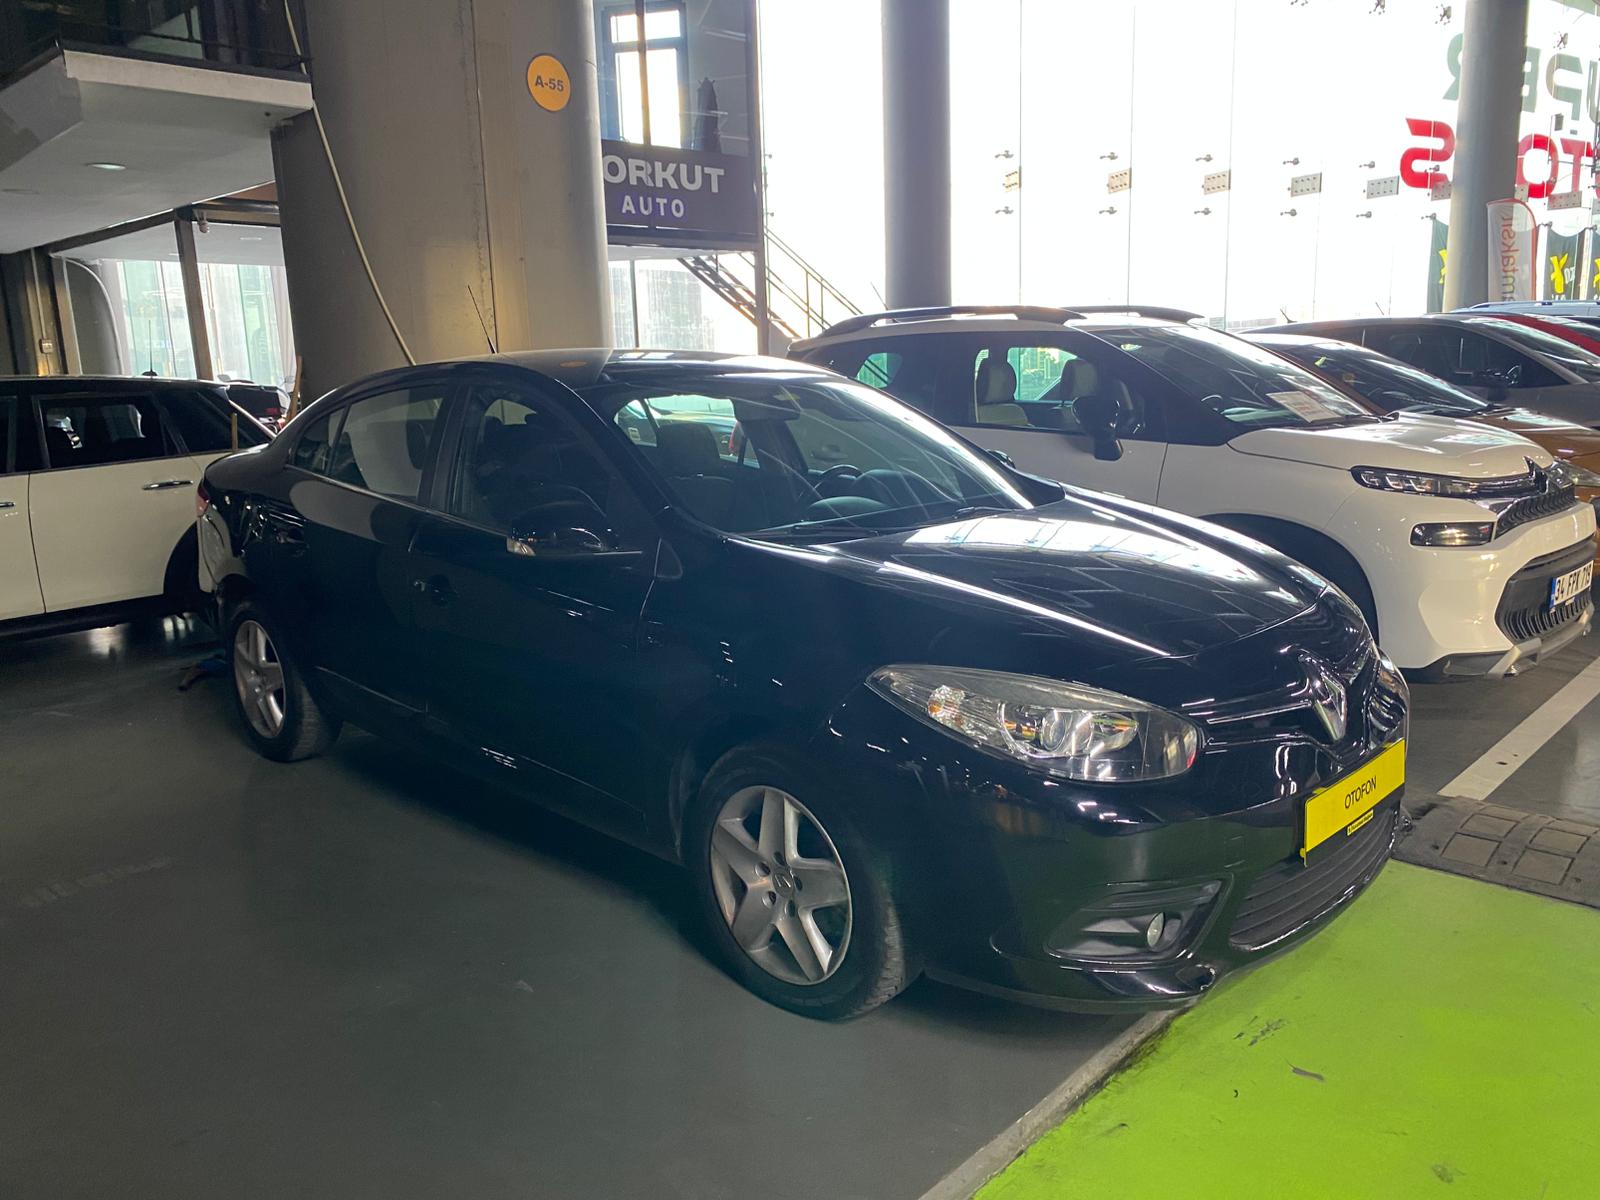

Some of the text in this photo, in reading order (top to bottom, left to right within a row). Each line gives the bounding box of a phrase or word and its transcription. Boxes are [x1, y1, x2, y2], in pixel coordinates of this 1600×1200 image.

[535, 75, 564, 92] A-55
[602, 155, 725, 193] ORKUT
[621, 195, 685, 218] AUTO
[1555, 577, 1565, 601] 34
[1345, 775, 1377, 809] OTOFON
